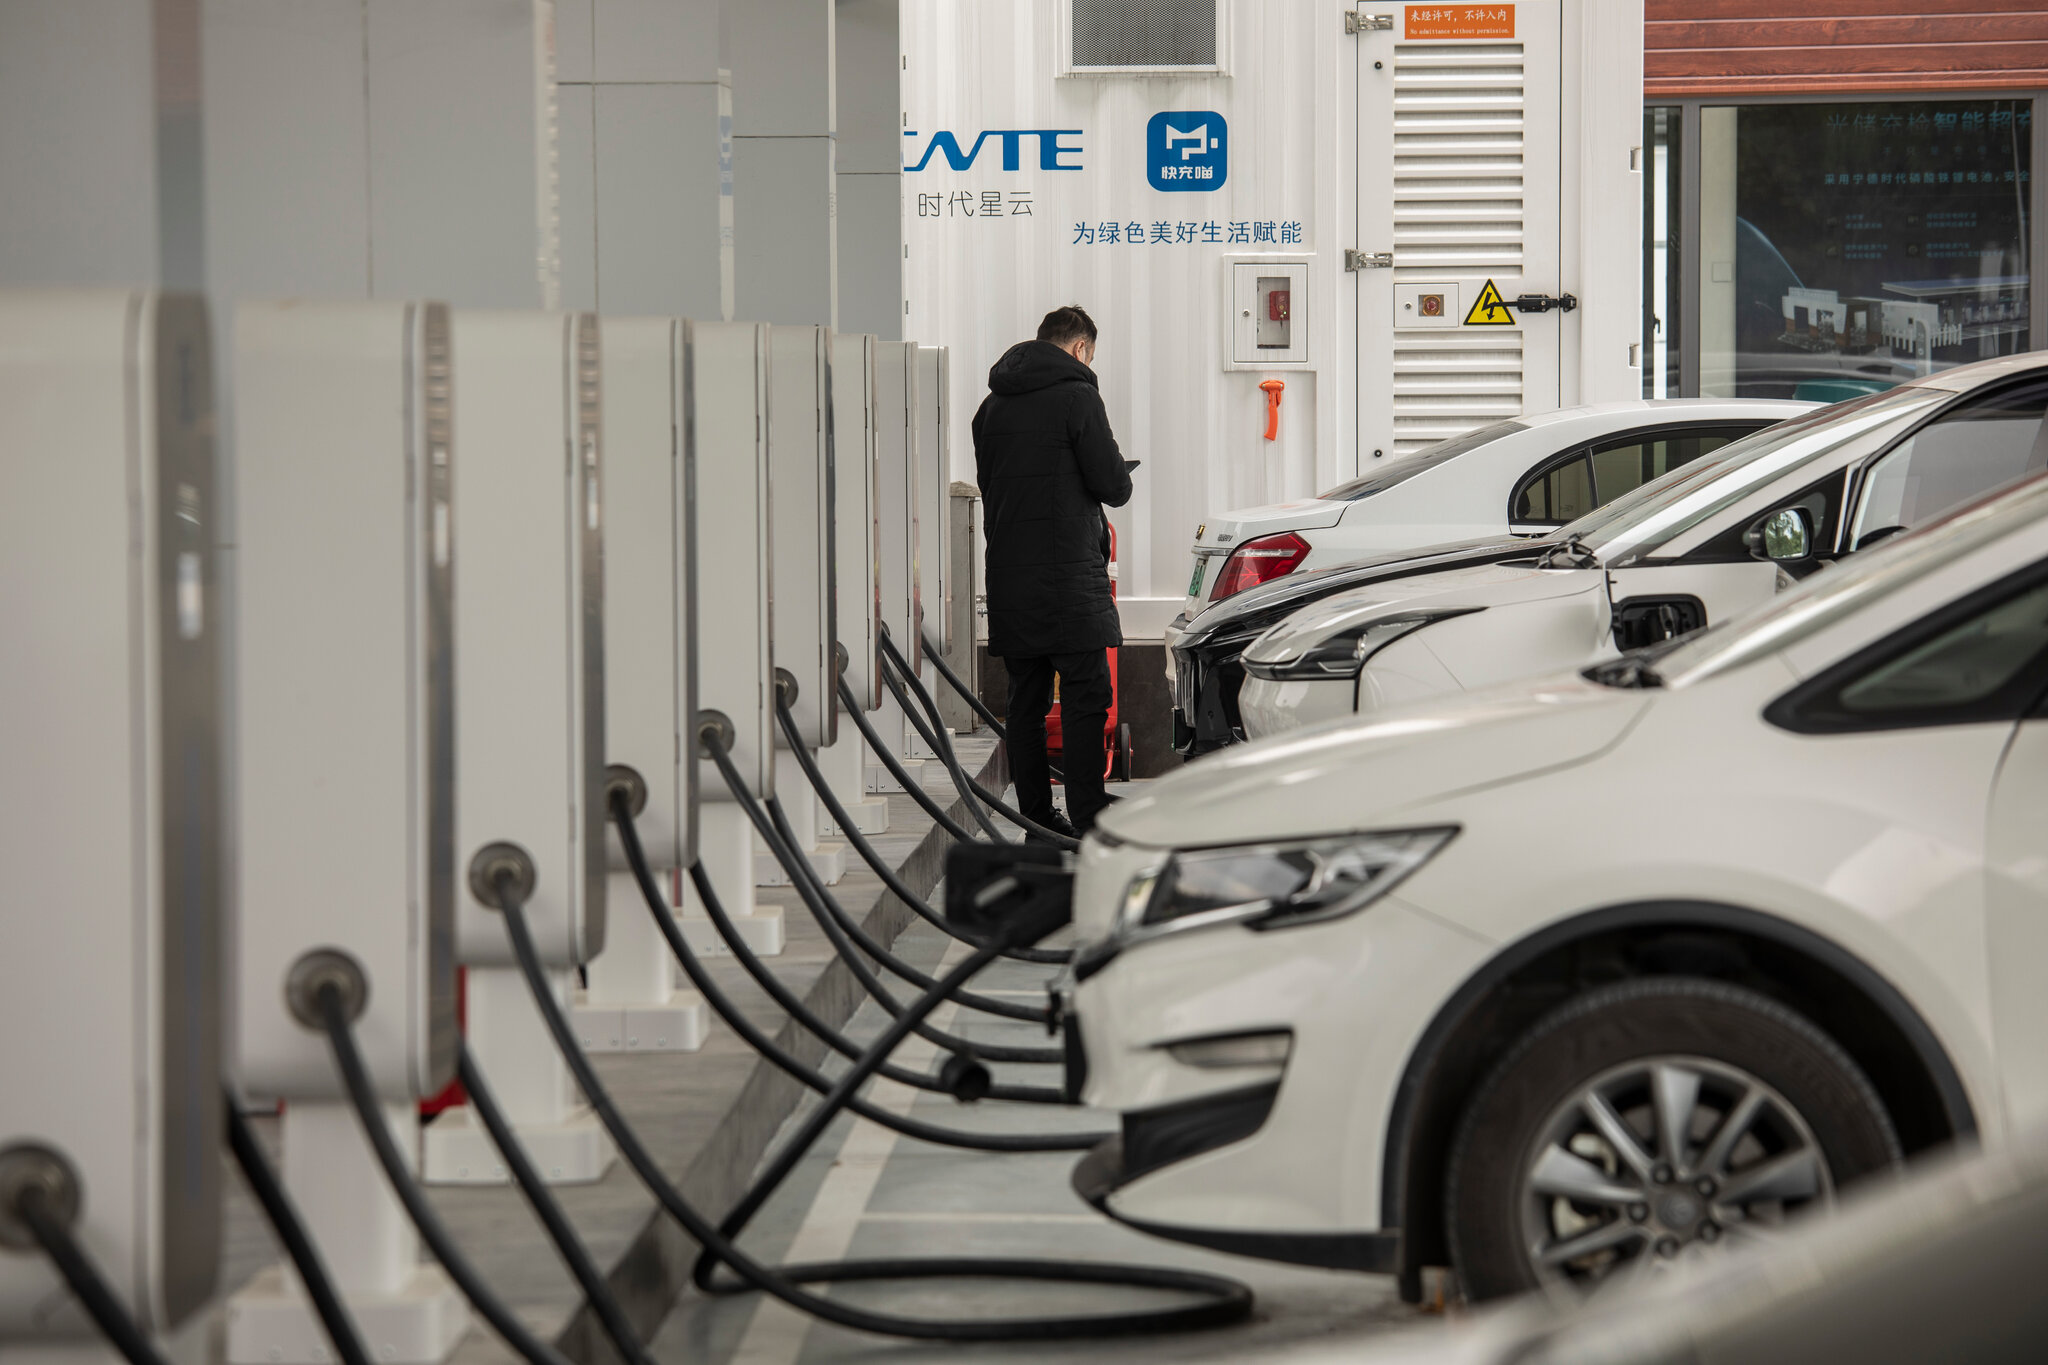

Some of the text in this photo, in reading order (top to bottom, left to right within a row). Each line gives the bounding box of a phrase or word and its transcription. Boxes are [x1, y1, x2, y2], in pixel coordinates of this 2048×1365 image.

[1410, 8, 1507, 22] 未经许可，不许入内
[1161, 165, 1214, 180] 快充喵
[918, 190, 1033, 217] 时代星云
[1072, 220, 1303, 245] 为绿色美好生活赋能
